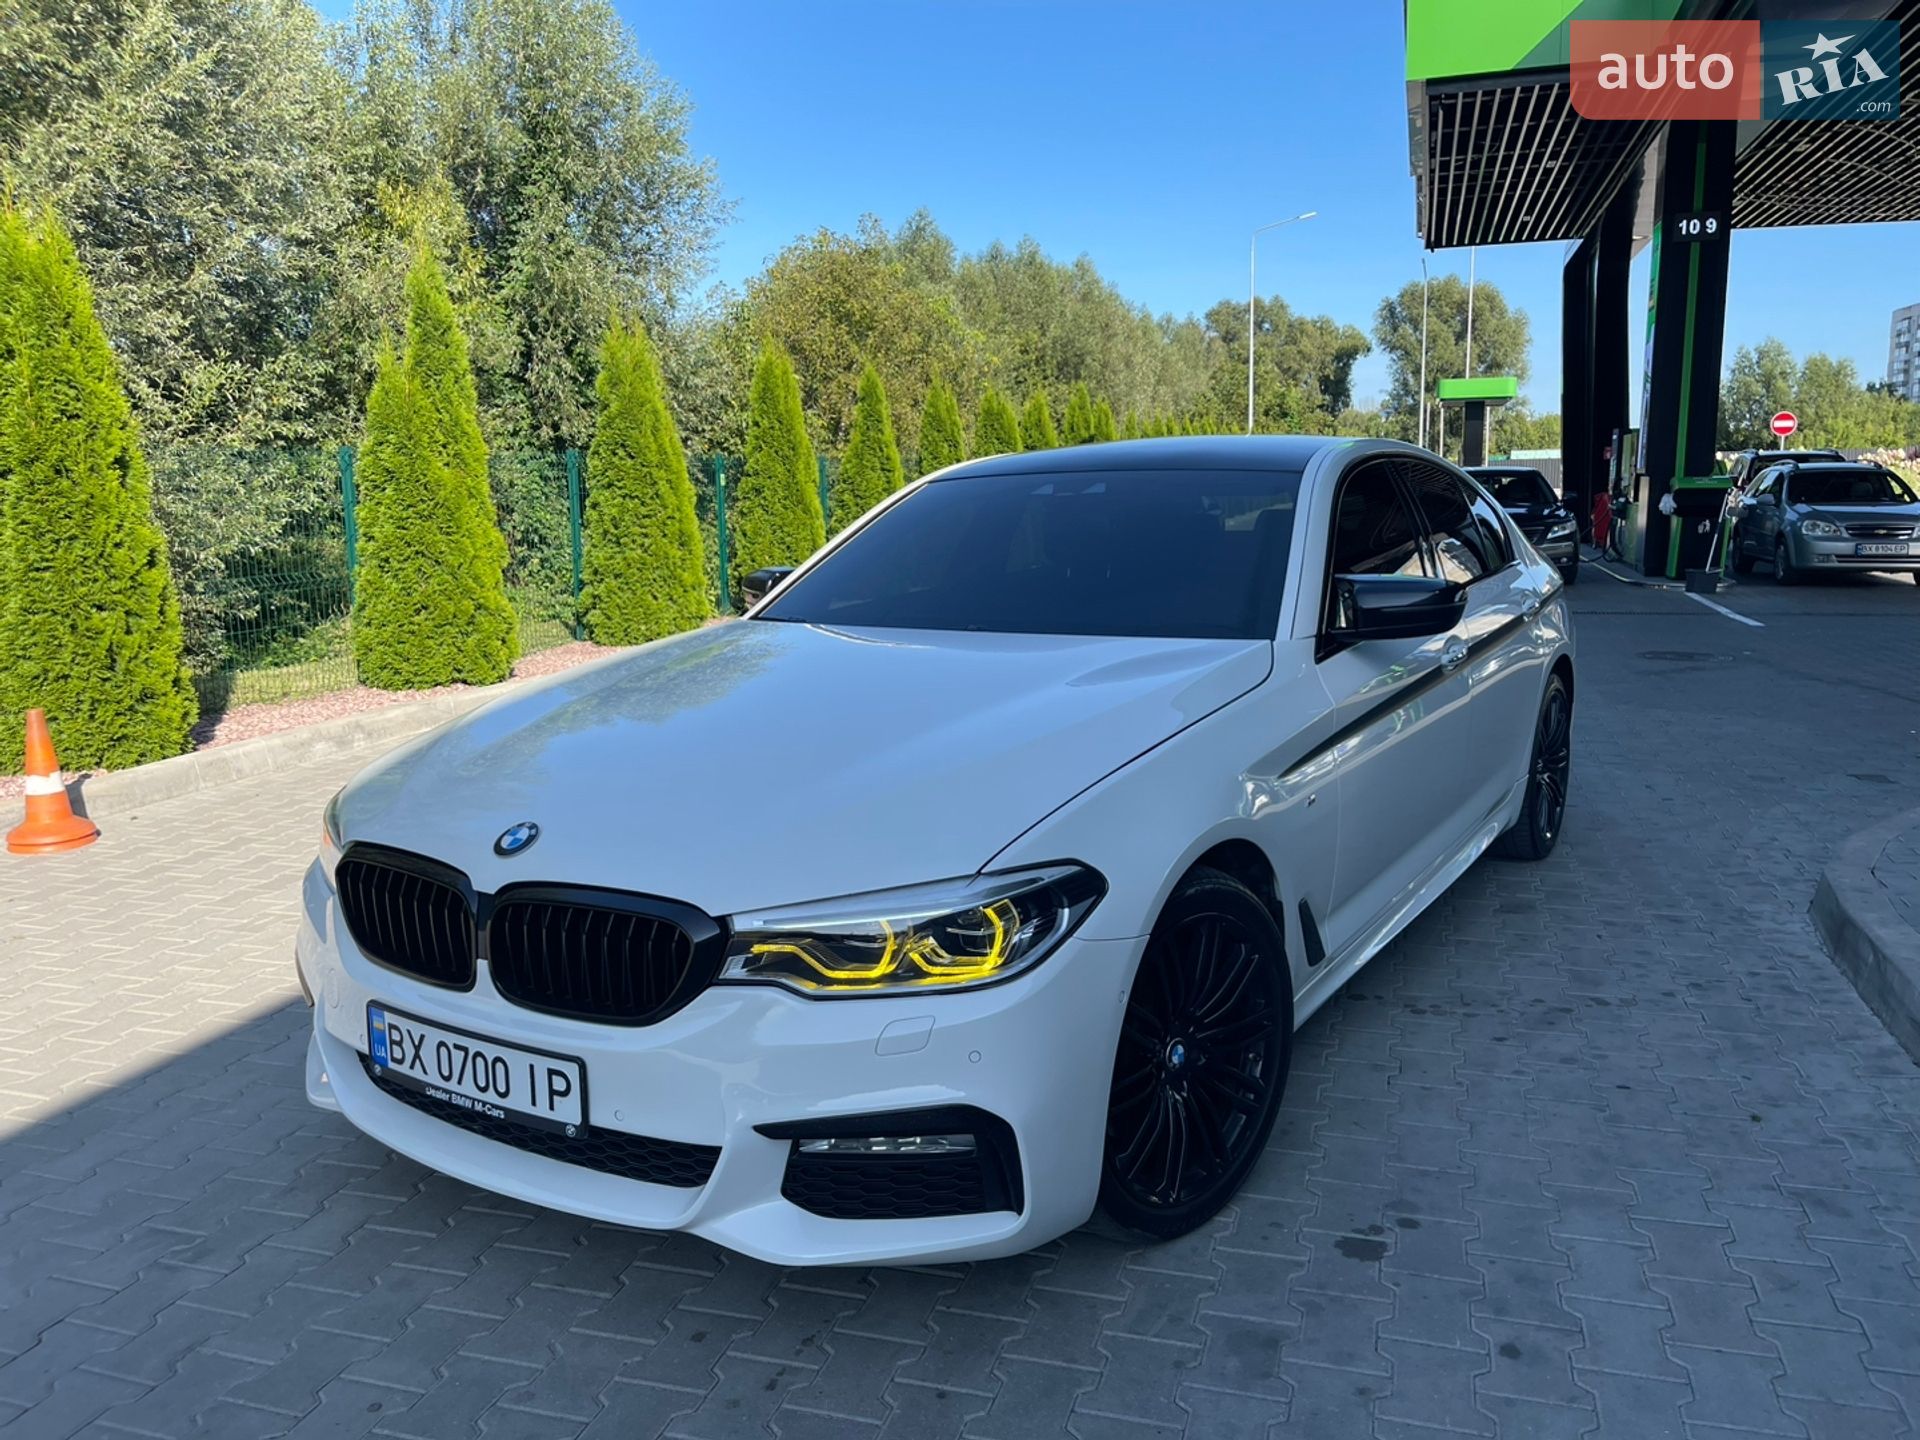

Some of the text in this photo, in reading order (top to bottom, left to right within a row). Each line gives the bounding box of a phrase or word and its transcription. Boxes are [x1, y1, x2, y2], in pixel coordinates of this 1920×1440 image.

[1679, 217, 1717, 235] 10 9
[374, 1045, 386, 1058] UA
[387, 1022, 572, 1111] BX 0700 IP
[451, 1093, 473, 1109] BMW
[474, 1101, 505, 1119] M-Cars
